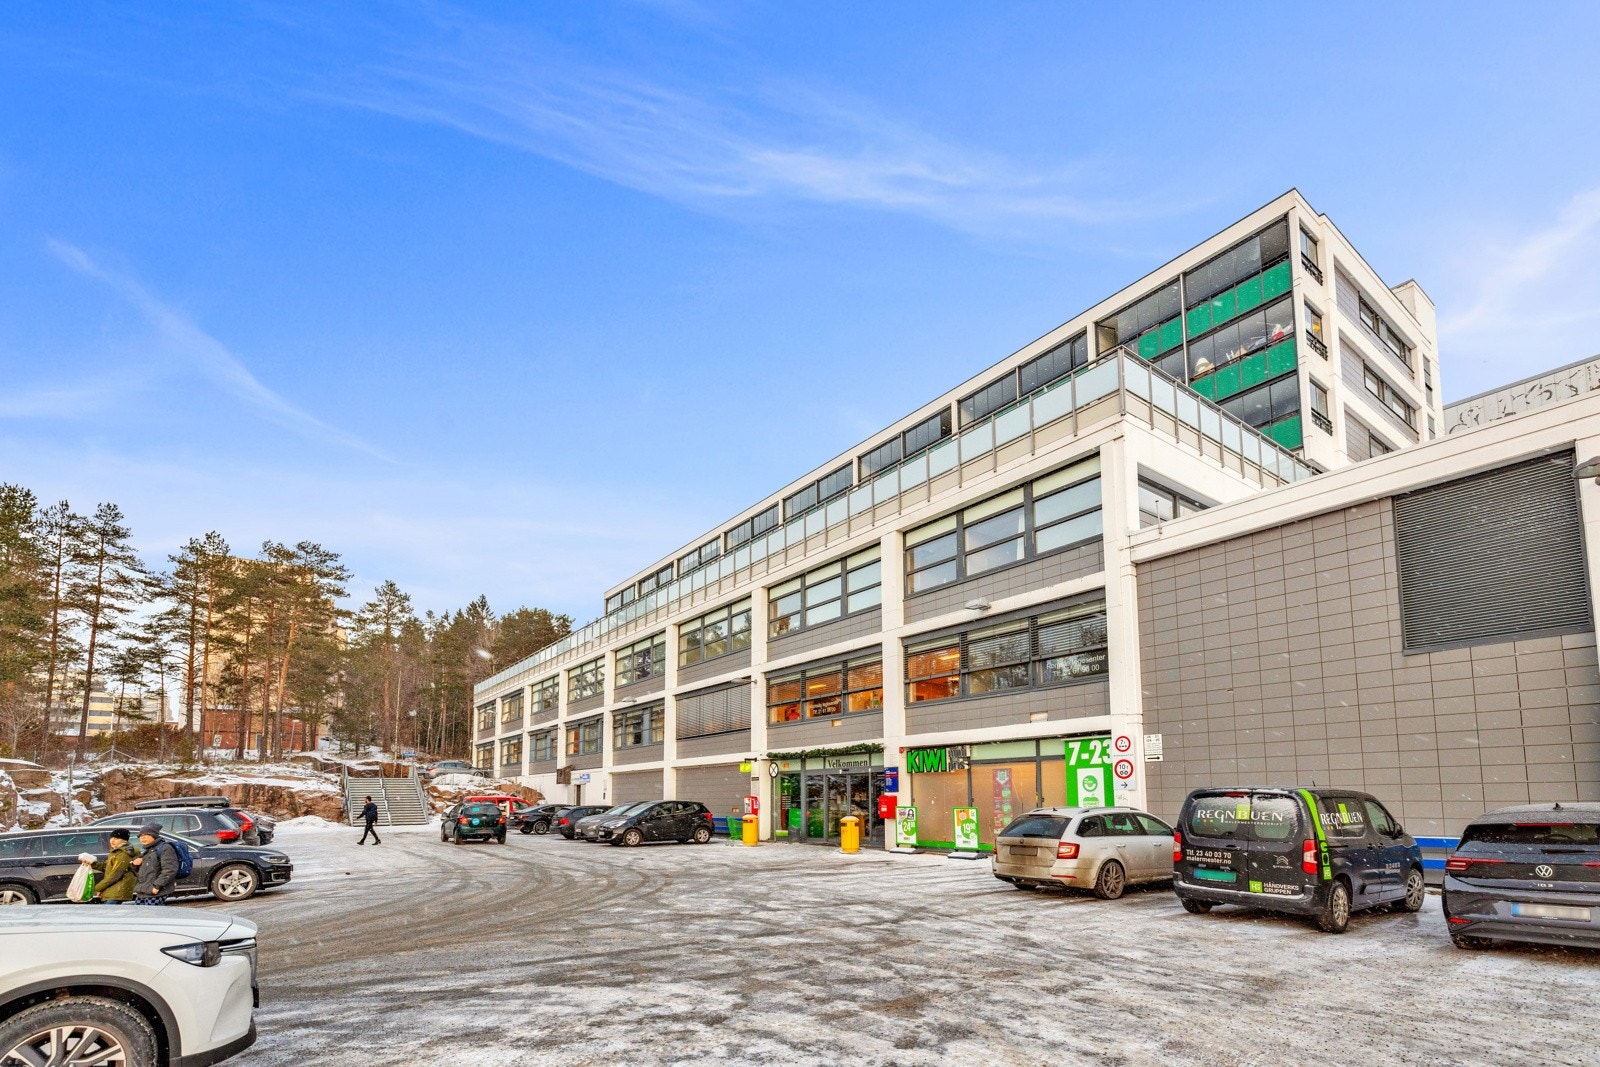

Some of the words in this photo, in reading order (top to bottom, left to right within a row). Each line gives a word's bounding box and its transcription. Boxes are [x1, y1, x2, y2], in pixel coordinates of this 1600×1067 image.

[1068, 739, 1112, 766] 7-23
[827, 759, 868, 768] Velkommen
[907, 748, 947, 773] KIWI
[1197, 810, 1283, 823] REGNBUEN
[1320, 811, 1364, 829] REGNBUEN
[1186, 856, 1232, 864] malermester.no
[1263, 882, 1300, 891] HÅNDVERKS
[1264, 887, 1292, 895] GRUPPEN
